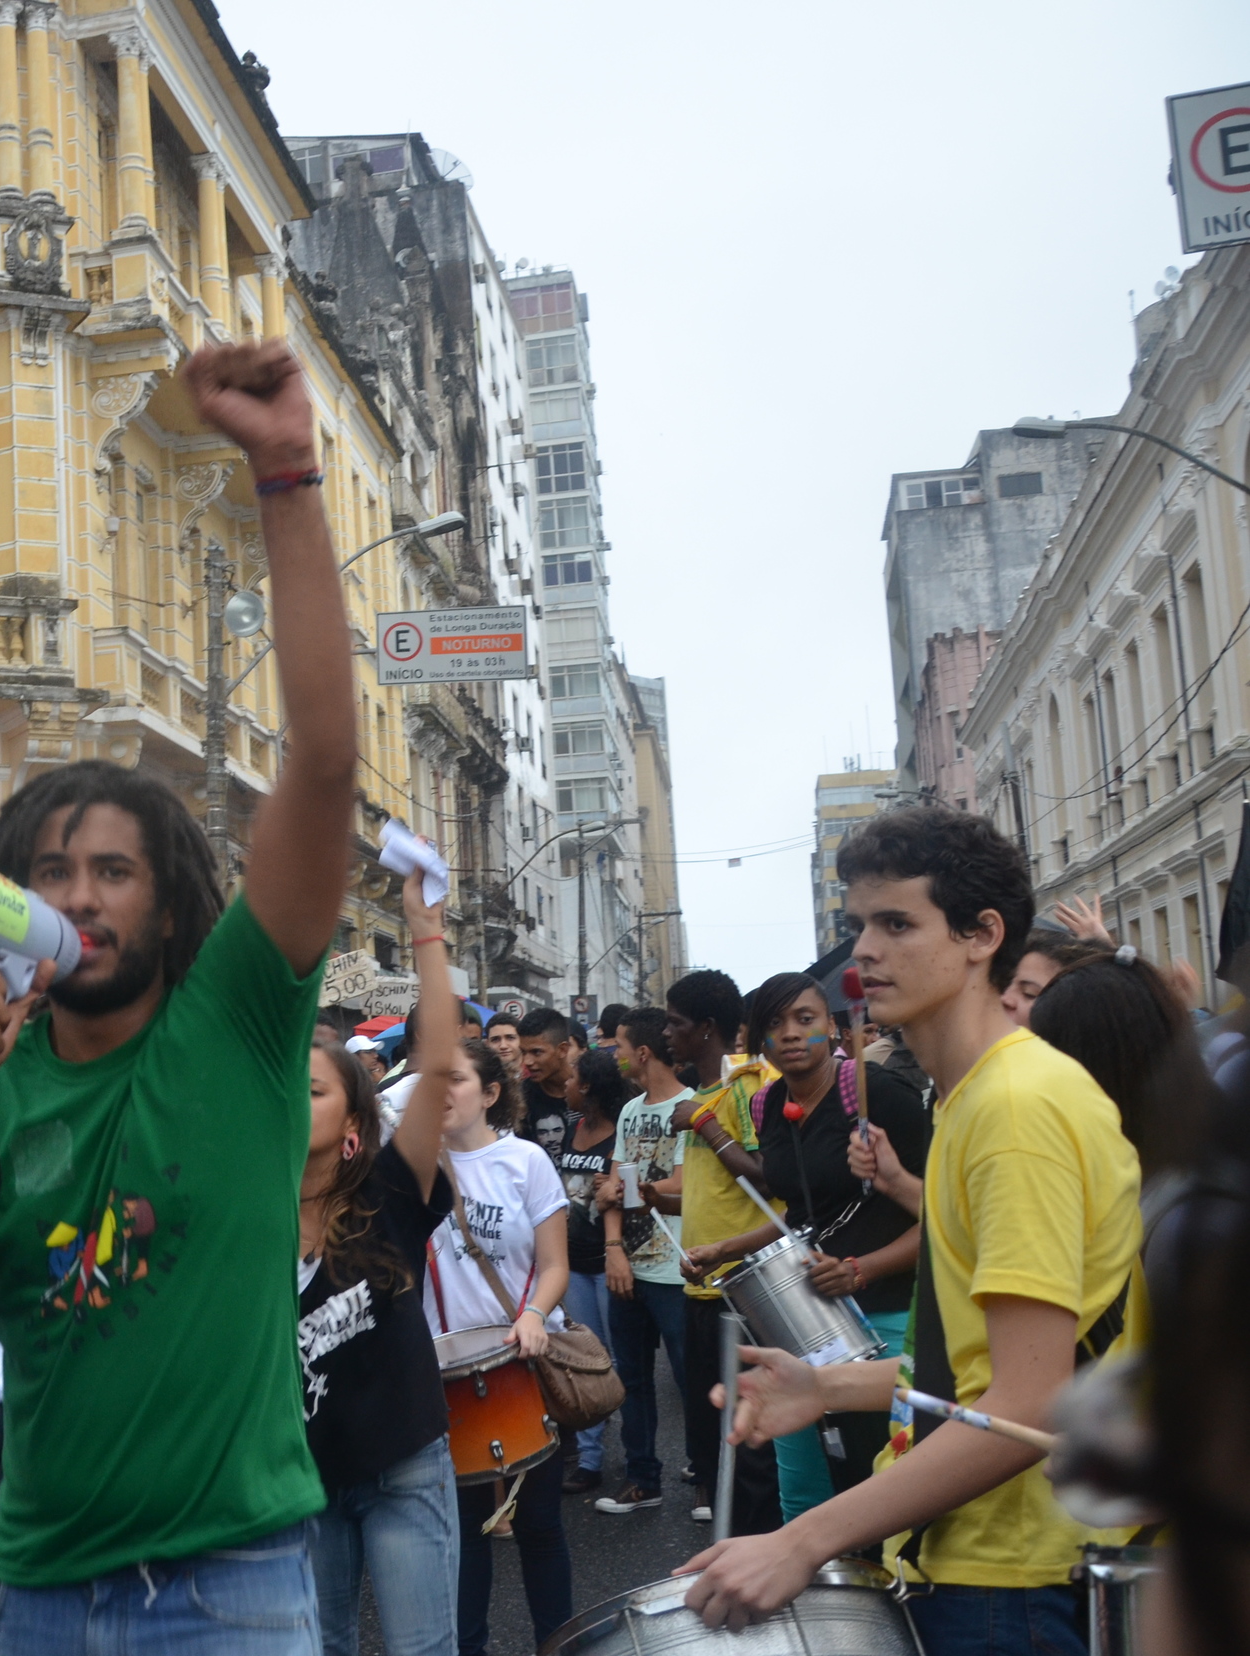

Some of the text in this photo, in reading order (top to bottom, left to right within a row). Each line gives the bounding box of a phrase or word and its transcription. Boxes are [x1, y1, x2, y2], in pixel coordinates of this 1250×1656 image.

[1219, 121, 1250, 177] E
[429, 611, 521, 623] Estacionamento
[430, 621, 523, 633] de Longa Duração
[395, 629, 411, 653] E
[442, 637, 513, 651] NOTURNO
[450, 658, 463, 668] 19
[467, 657, 480, 667] às
[385, 667, 424, 680] INÍCIO
[324, 952, 358, 979] CHIN
